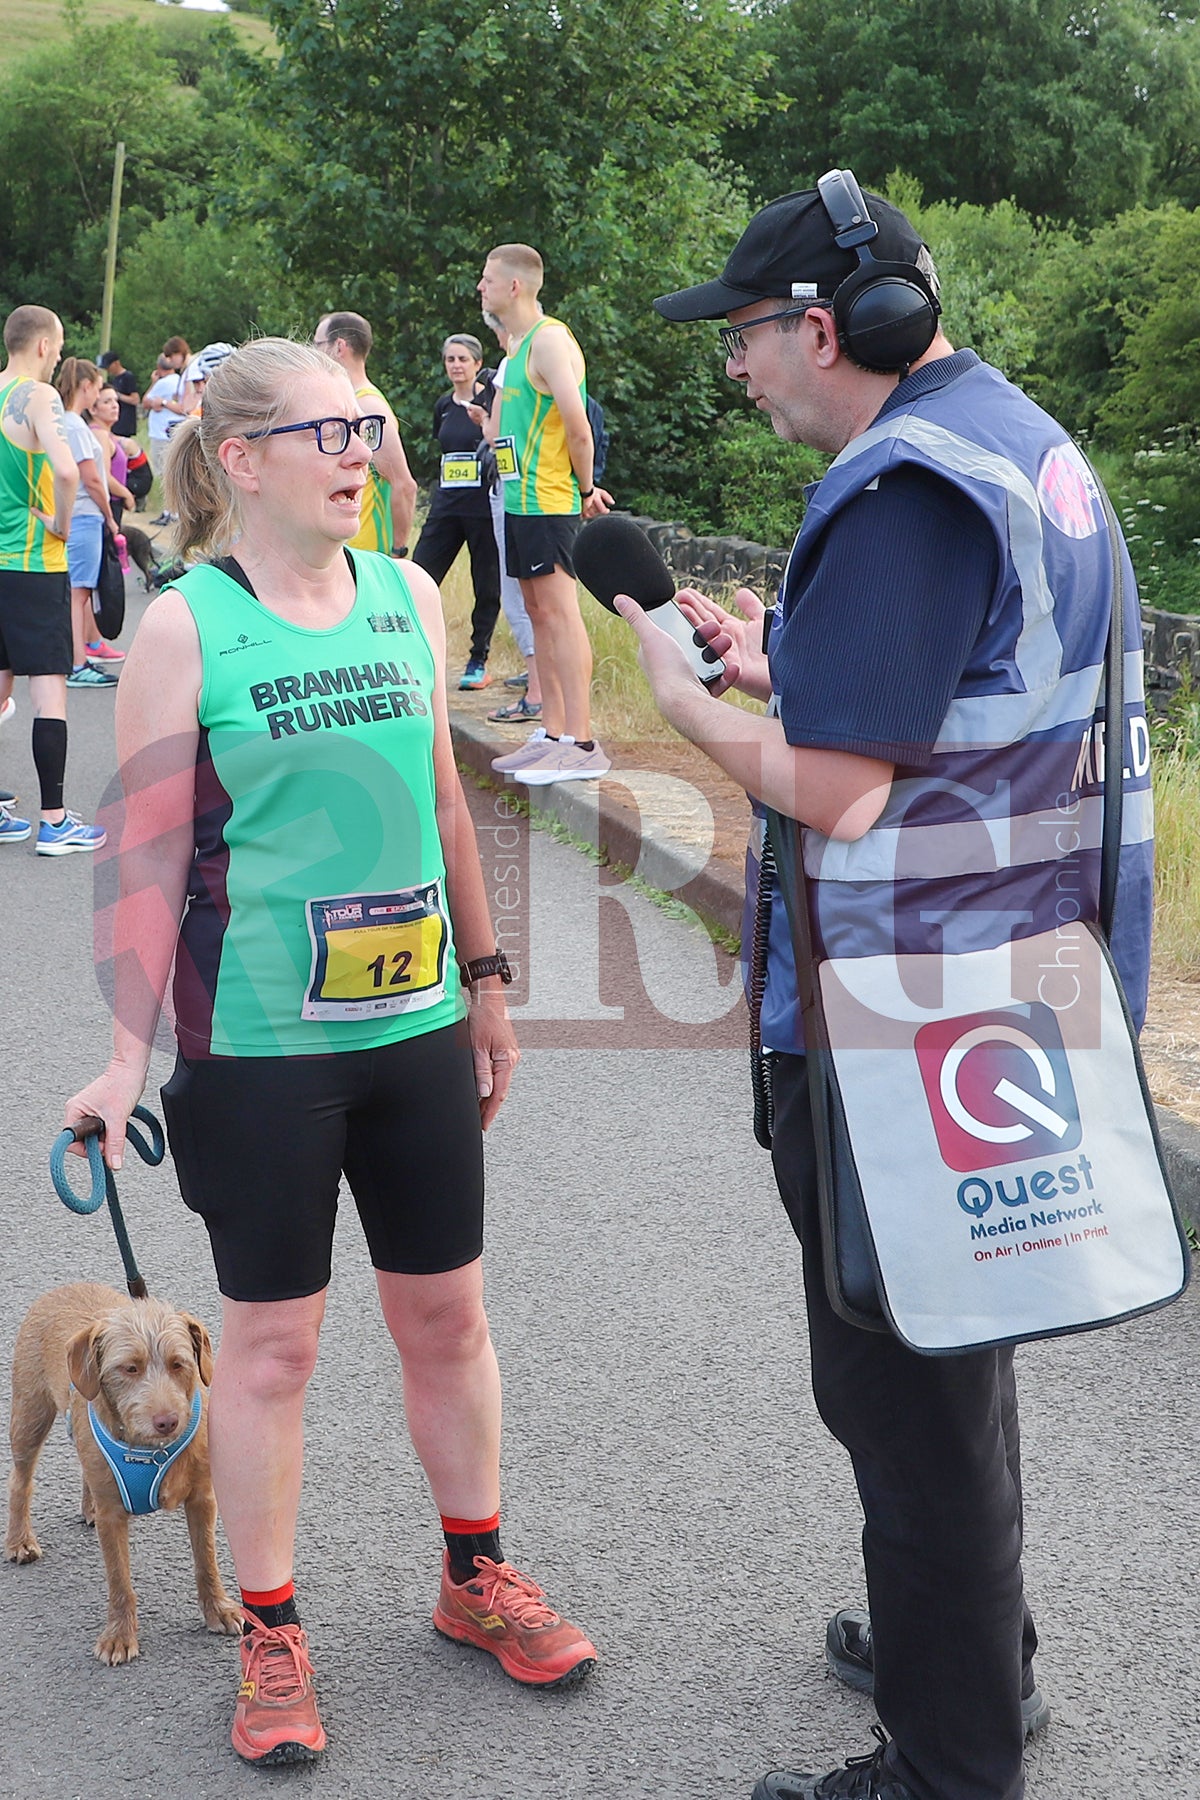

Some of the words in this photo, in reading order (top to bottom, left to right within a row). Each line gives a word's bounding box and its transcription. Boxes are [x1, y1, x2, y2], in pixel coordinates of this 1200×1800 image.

[448, 468, 469, 478] 294
[219, 639, 272, 656] RONHILL
[249, 661, 421, 712] BRAMHALL
[266, 690, 428, 740] RUNNERS
[366, 950, 412, 988] 12
[956, 1154, 1095, 1218] Quest
[970, 1216, 1027, 1240] Media
[1031, 1199, 1104, 1228] Network
[974, 1250, 992, 1262] On
[995, 1247, 1013, 1258] Air
[1022, 1236, 1062, 1253] Online
[1070, 1232, 1081, 1243] In
[1083, 1225, 1109, 1240] Print
